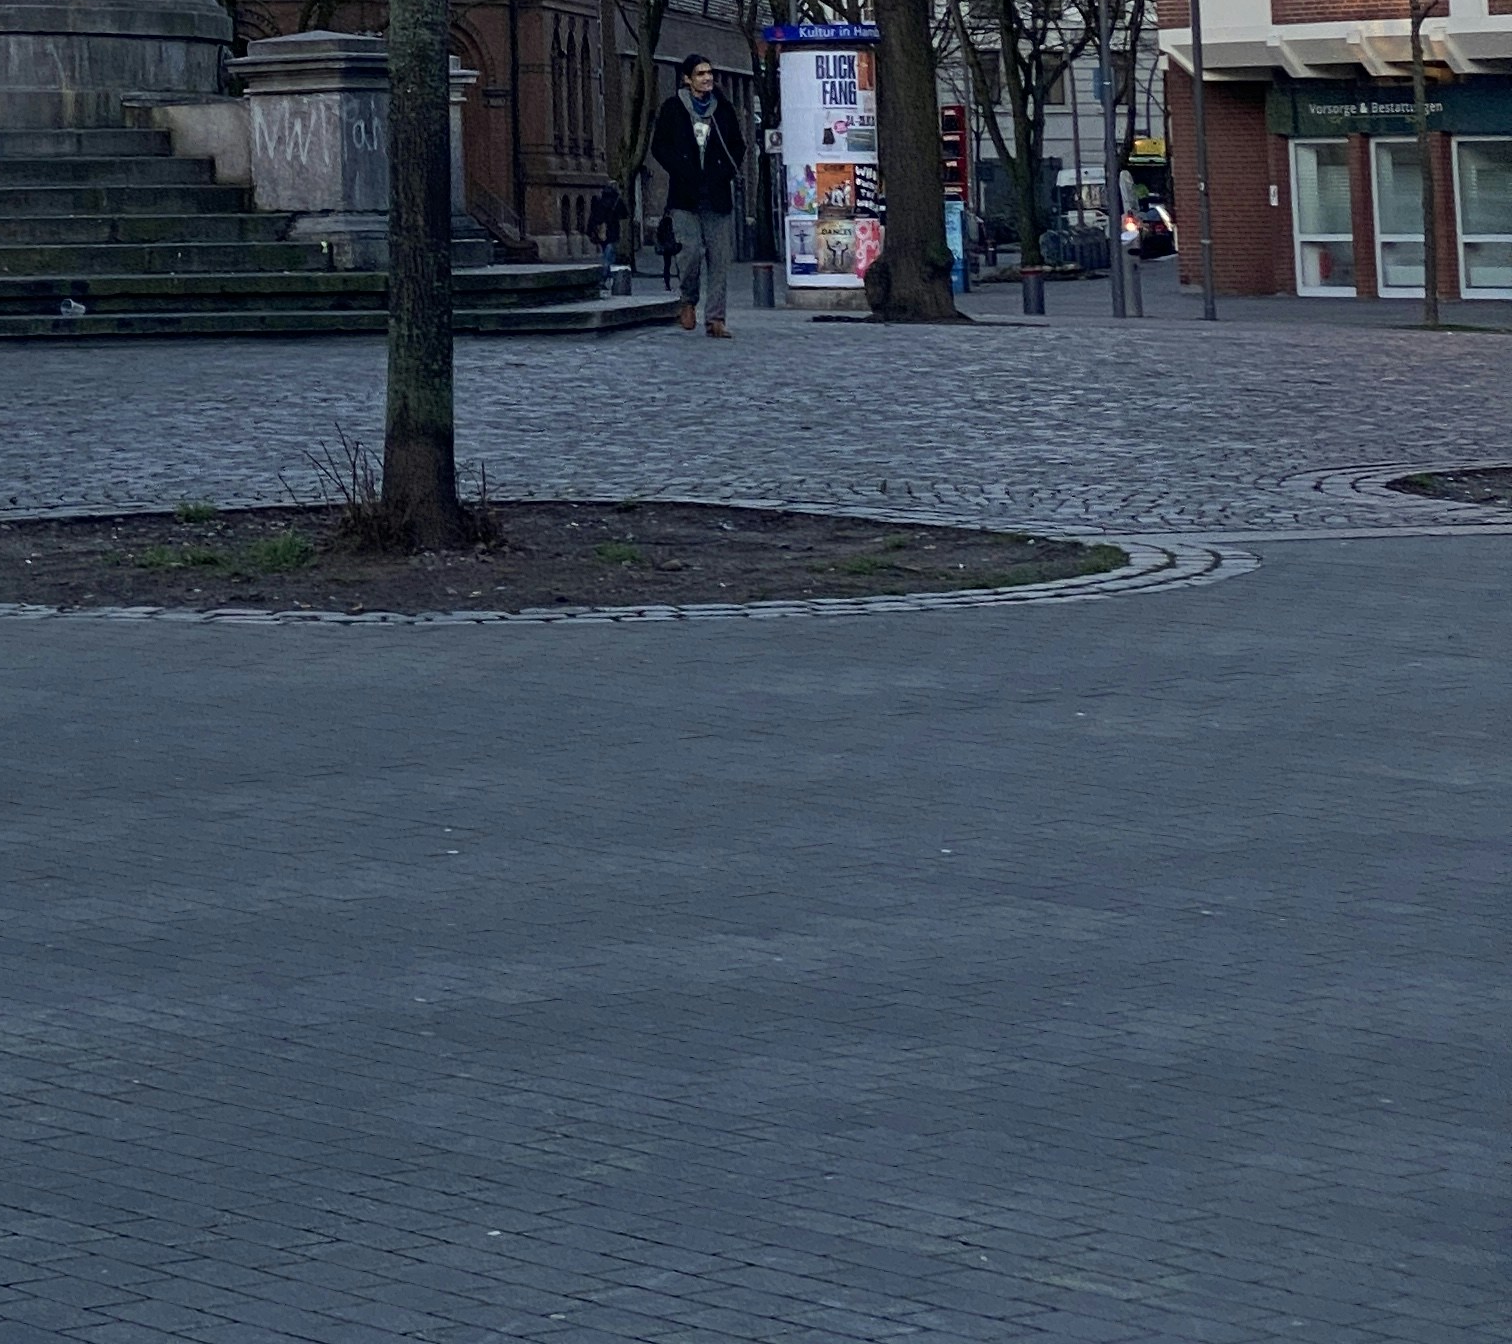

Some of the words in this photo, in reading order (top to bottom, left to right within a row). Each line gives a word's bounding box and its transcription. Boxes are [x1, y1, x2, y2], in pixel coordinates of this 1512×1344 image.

[799, 26, 835, 38] Kultur
[839, 26, 852, 37] in
[815, 54, 856, 80] BLICK
[822, 80, 857, 106] FANG
[1308, 103, 1357, 117] Vorsorge
[1359, 102, 1369, 114] &
